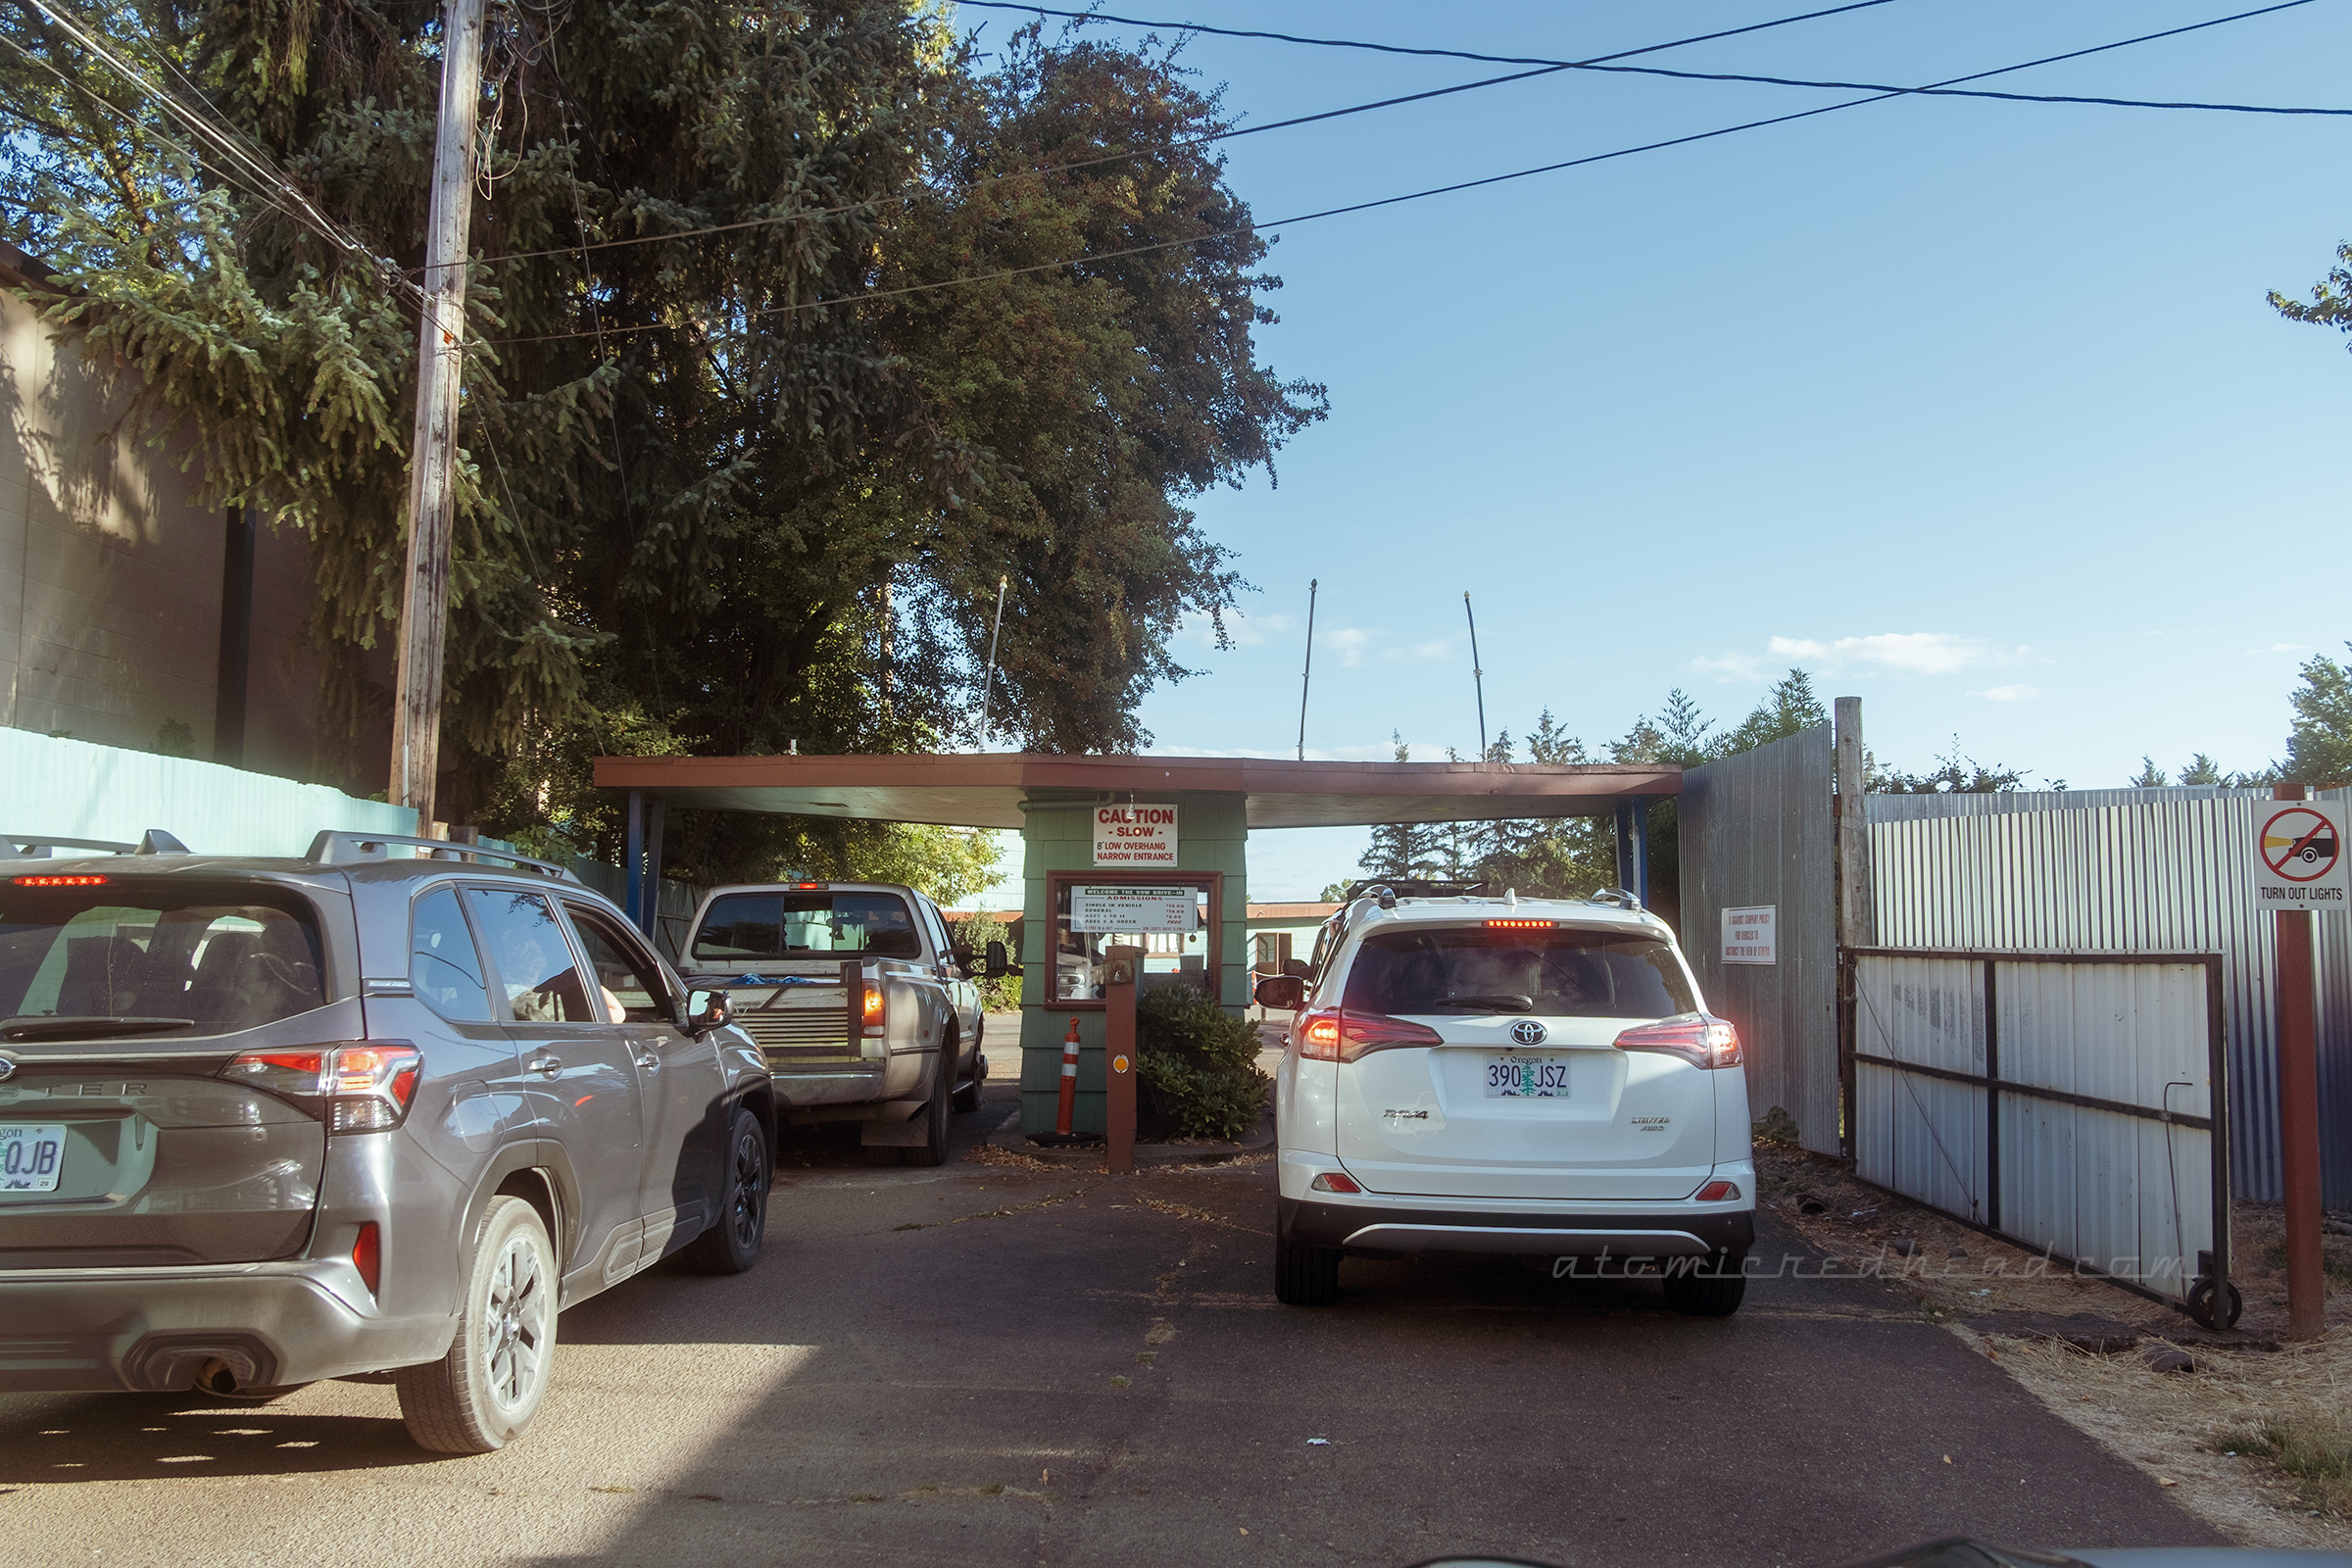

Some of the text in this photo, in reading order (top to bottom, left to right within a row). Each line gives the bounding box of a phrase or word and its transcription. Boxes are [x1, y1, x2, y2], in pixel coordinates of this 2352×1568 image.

[1099, 808, 1173, 823] CAUTION
[1116, 827, 1154, 837] SLOW
[1104, 842, 1121, 851] LOW
[1123, 842, 1166, 851] OVERHANG
[1097, 852, 1131, 860] NARROW
[2260, 887, 2343, 901] TURN OUT LIGHTS
[1510, 1055, 1543, 1065] Oregon
[1488, 1064, 1567, 1088] 390 JSZ
